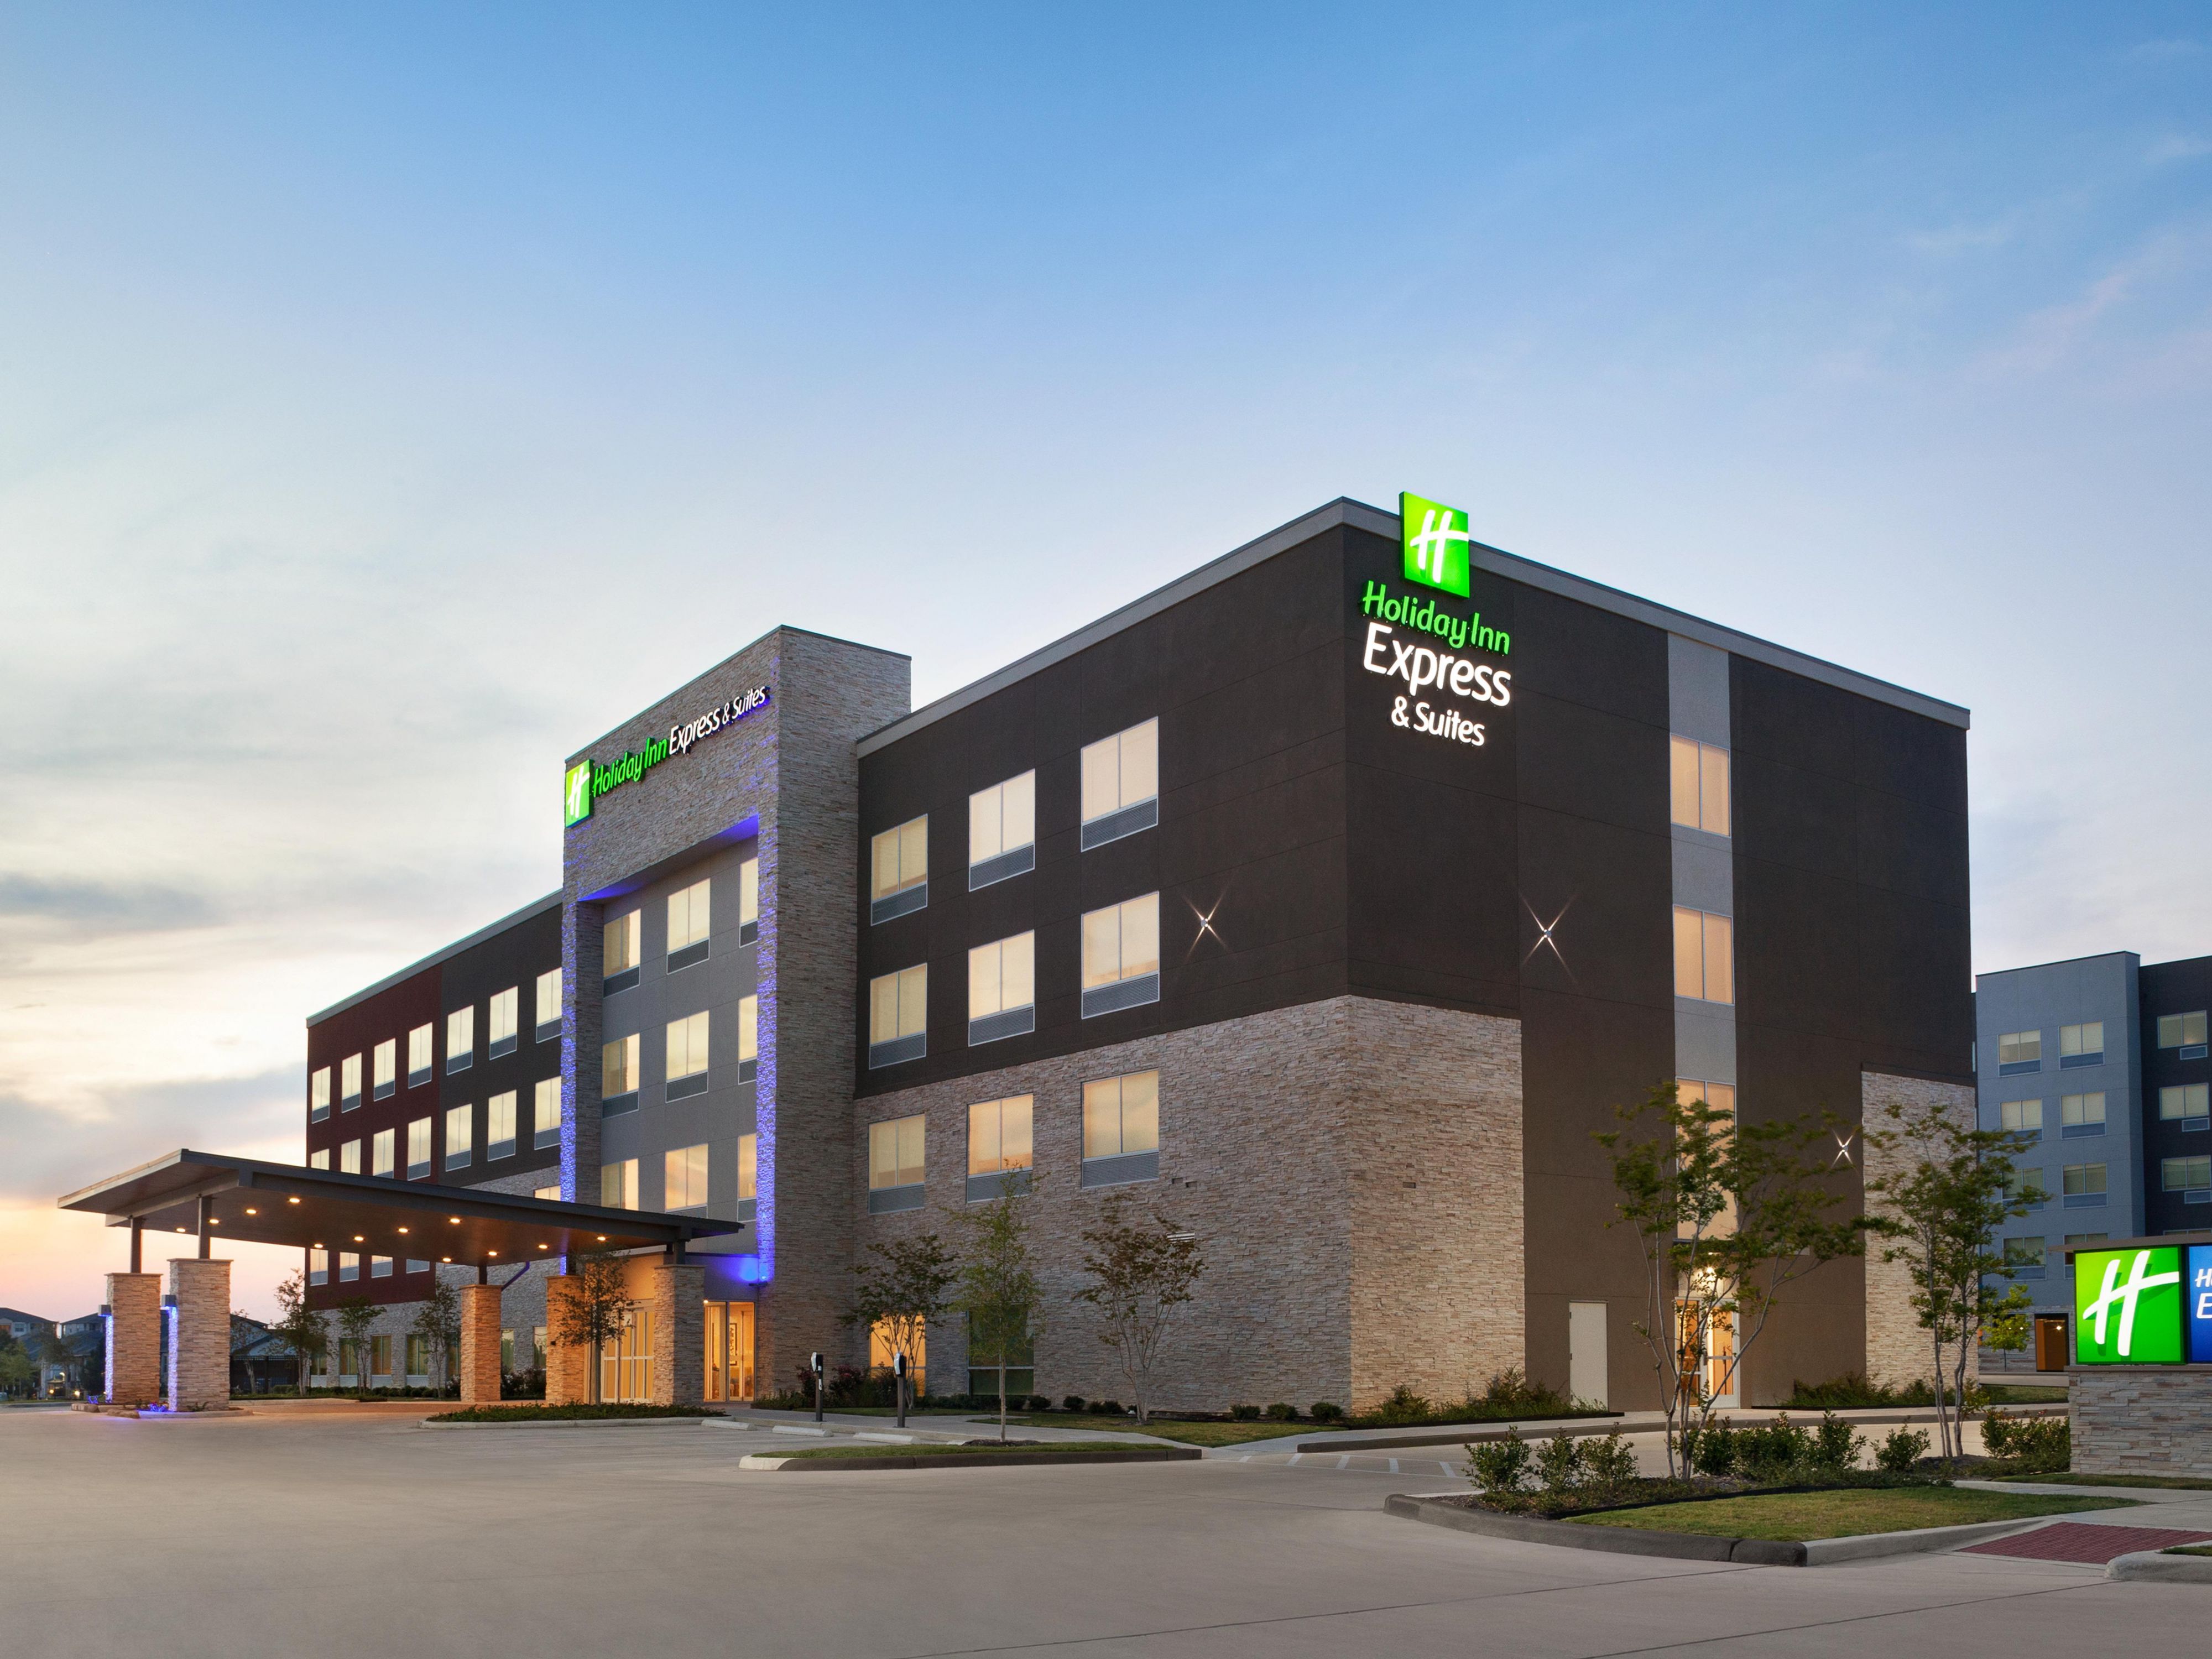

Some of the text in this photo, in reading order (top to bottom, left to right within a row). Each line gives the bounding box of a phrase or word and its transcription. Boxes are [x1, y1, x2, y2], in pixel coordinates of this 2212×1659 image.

[1363, 580, 1510, 655] Holiday Inn
[1363, 622, 1511, 707] Express
[592, 686, 765, 797] Holiday Inn Express & Suites
[1391, 696, 1485, 747] & Suites
[2194, 1268, 2212, 1288] H
